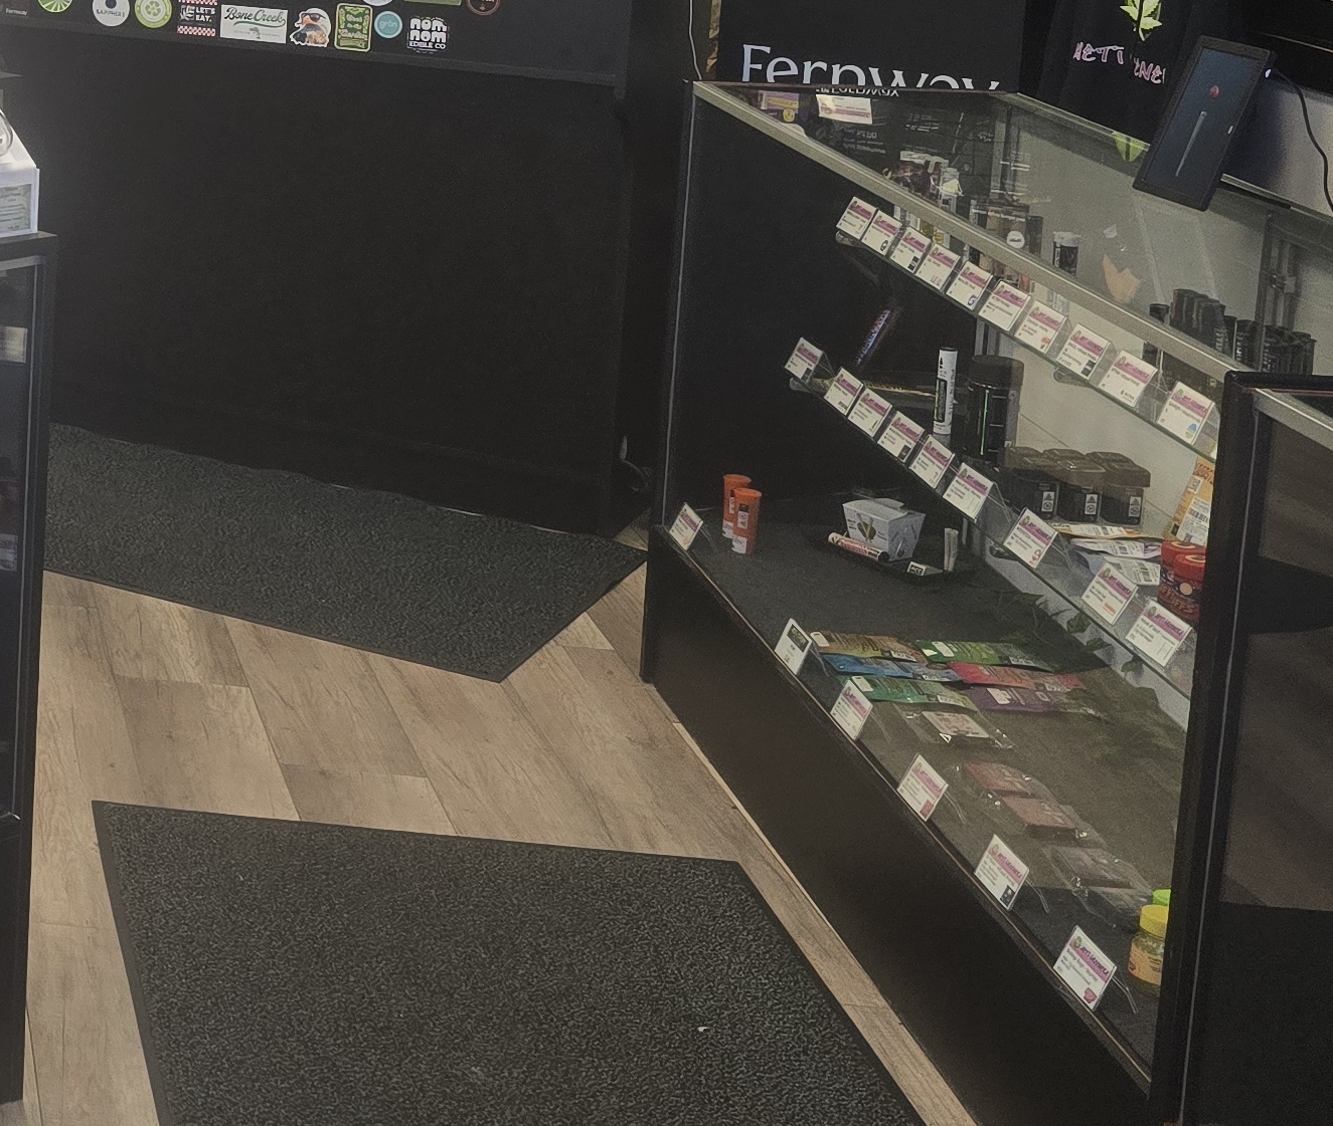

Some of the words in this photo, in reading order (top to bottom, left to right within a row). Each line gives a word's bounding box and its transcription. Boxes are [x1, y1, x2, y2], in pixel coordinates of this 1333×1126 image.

[196, 6, 215, 14] LET'S
[224, 7, 253, 20] Bone
[254, 9, 285, 23] Creek
[410, 18, 447, 31] nom
[410, 30, 447, 43] nom
